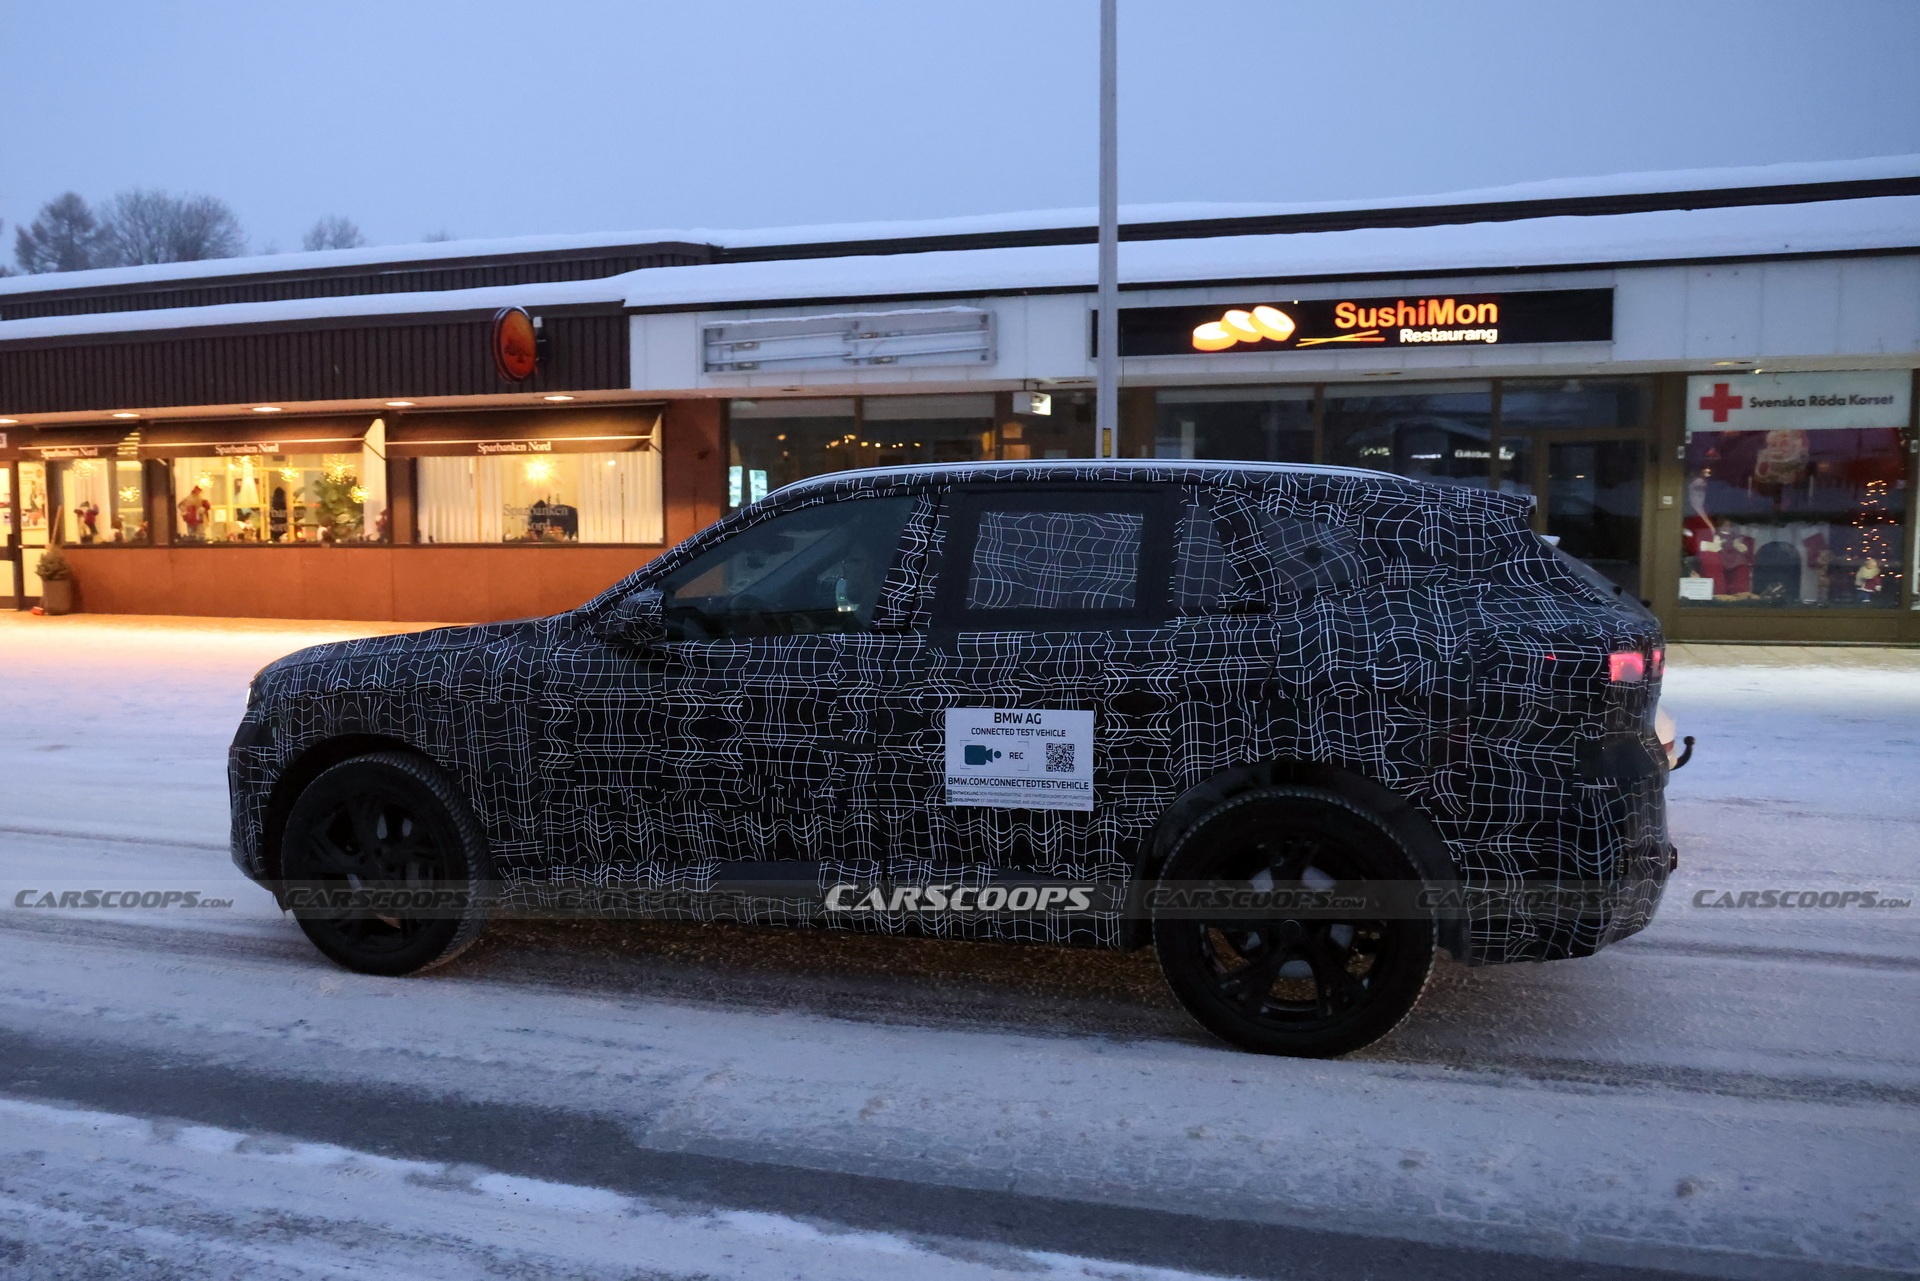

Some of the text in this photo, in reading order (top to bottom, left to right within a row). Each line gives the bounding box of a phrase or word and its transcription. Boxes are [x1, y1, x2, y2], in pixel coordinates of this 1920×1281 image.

[1335, 298, 1498, 328] SushiMon
[1400, 328, 1498, 343] Restaurang
[1750, 394, 1894, 408] Svenska Röda Korset
[258, 443, 280, 453] Nord
[477, 440, 552, 455] Sparbanken Nord
[994, 712, 1042, 724] BMW AG
[971, 727, 1066, 738] CONNECTED TEST VEHICLE
[1009, 752, 1024, 760] REC
[948, 777, 1089, 790] BMW.COM/CONNECTEDTESTVEHICLE
